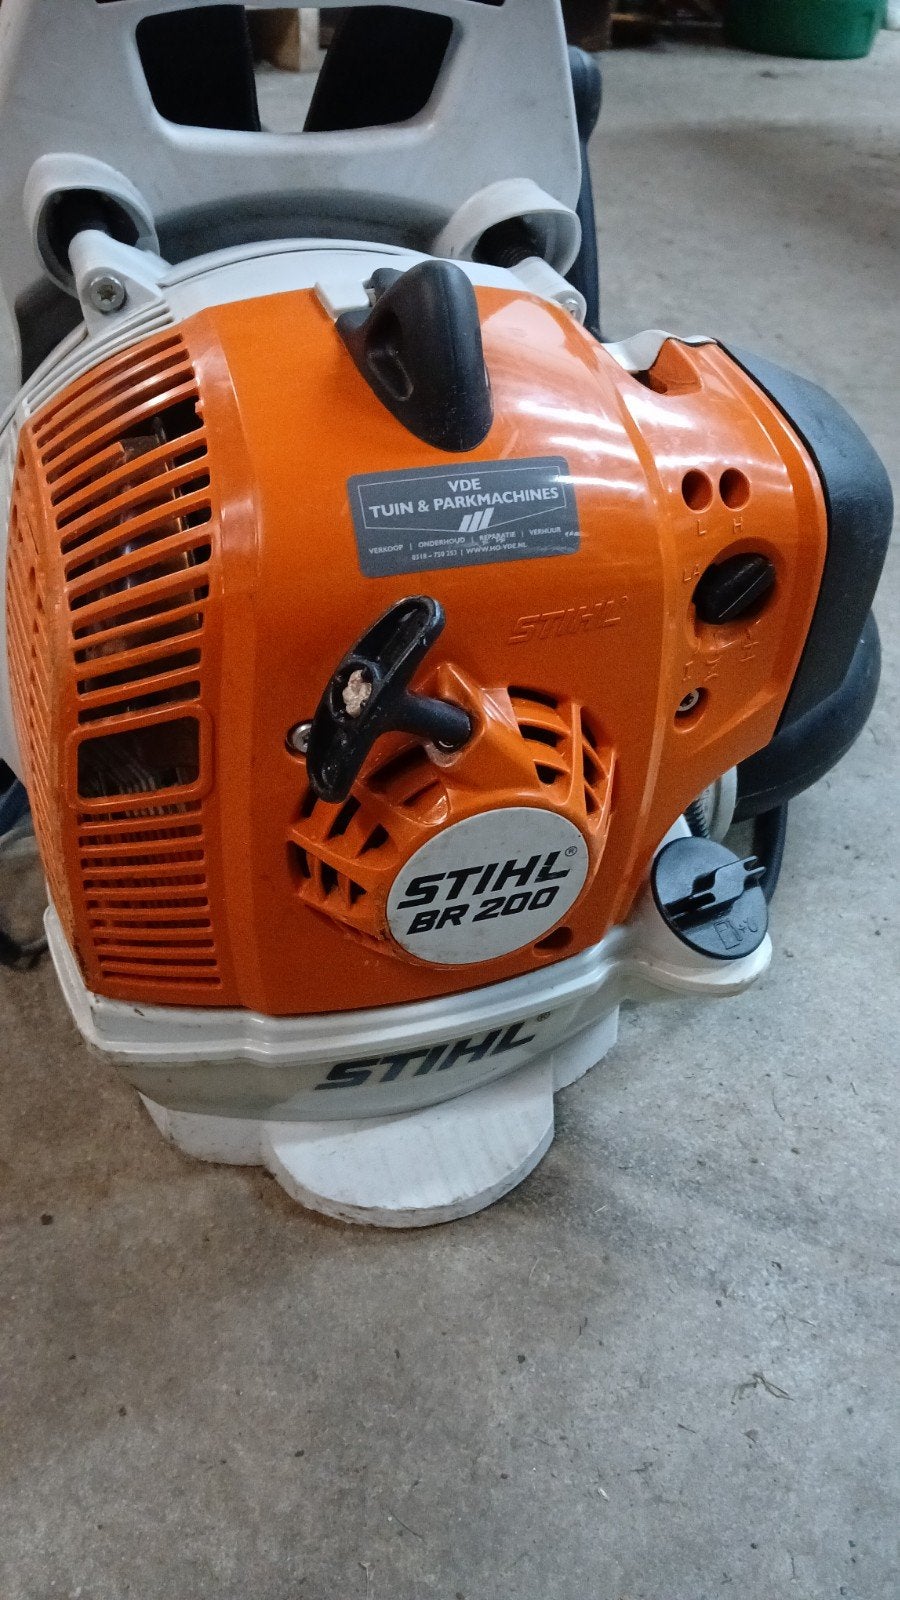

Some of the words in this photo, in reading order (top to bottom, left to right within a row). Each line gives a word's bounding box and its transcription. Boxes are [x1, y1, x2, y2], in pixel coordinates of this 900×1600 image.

[368, 503, 414, 519] TUIN
[417, 500, 430, 513] &
[433, 487, 559, 511] PARKMACHINES
[447, 478, 482, 493] VDE
[368, 544, 404, 555] VERKOOP
[417, 536, 466, 549] ONDERHOUD
[479, 530, 517, 542] REPARATIE
[529, 526, 562, 537] VERHUUR
[506, 600, 621, 646] STIHL
[397, 850, 571, 910] STIHL
[406, 903, 470, 935] BR
[472, 886, 560, 923] 200
[314, 1021, 536, 1091] STIHL
